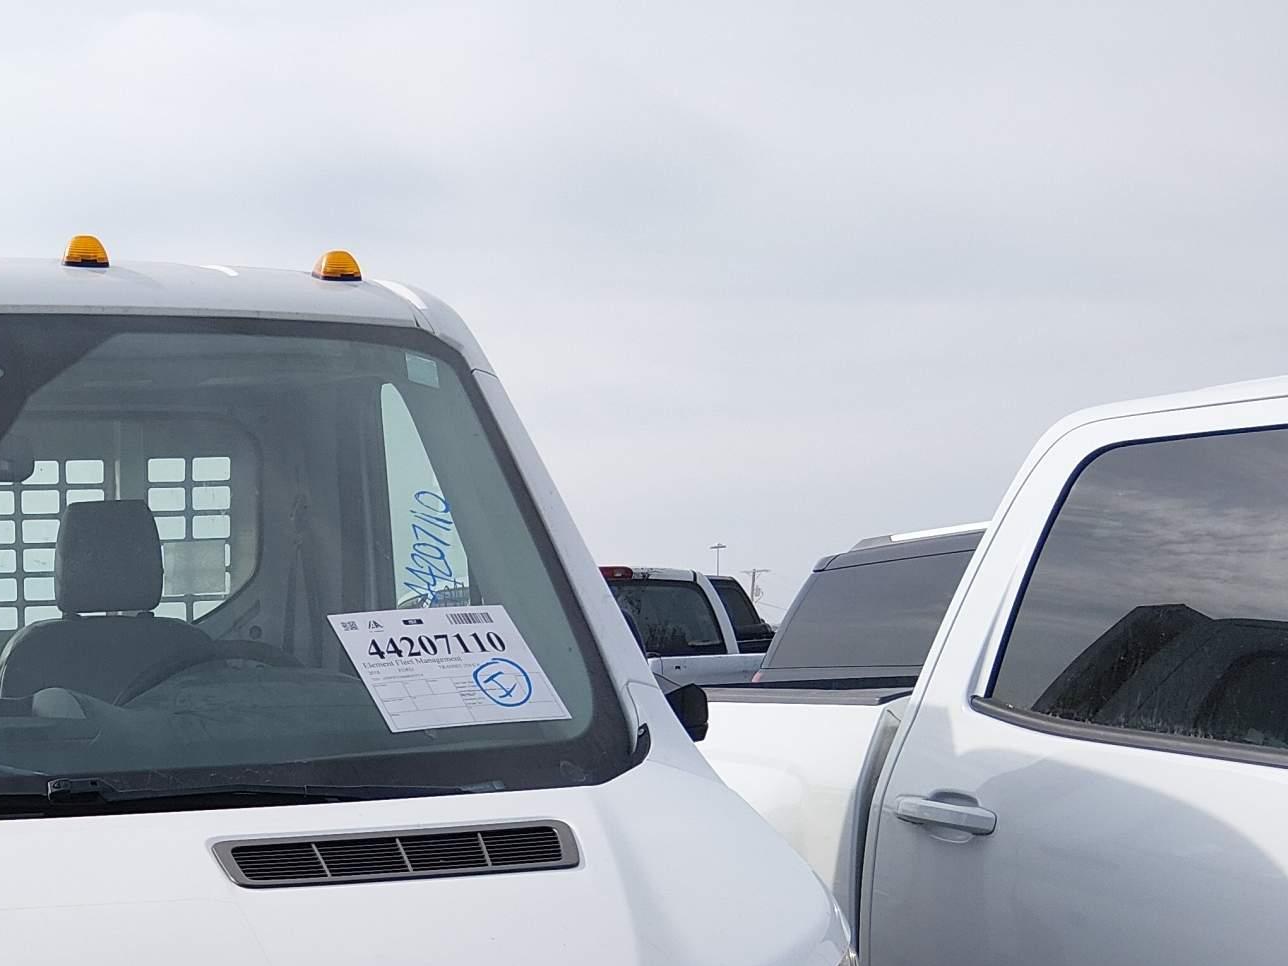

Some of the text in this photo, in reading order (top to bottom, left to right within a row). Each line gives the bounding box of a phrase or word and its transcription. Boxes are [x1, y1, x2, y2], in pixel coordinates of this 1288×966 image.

[367, 631, 507, 660] 44207110
[362, 660, 394, 669] Element
[395, 658, 415, 667] Fleet
[415, 655, 463, 665] Management
